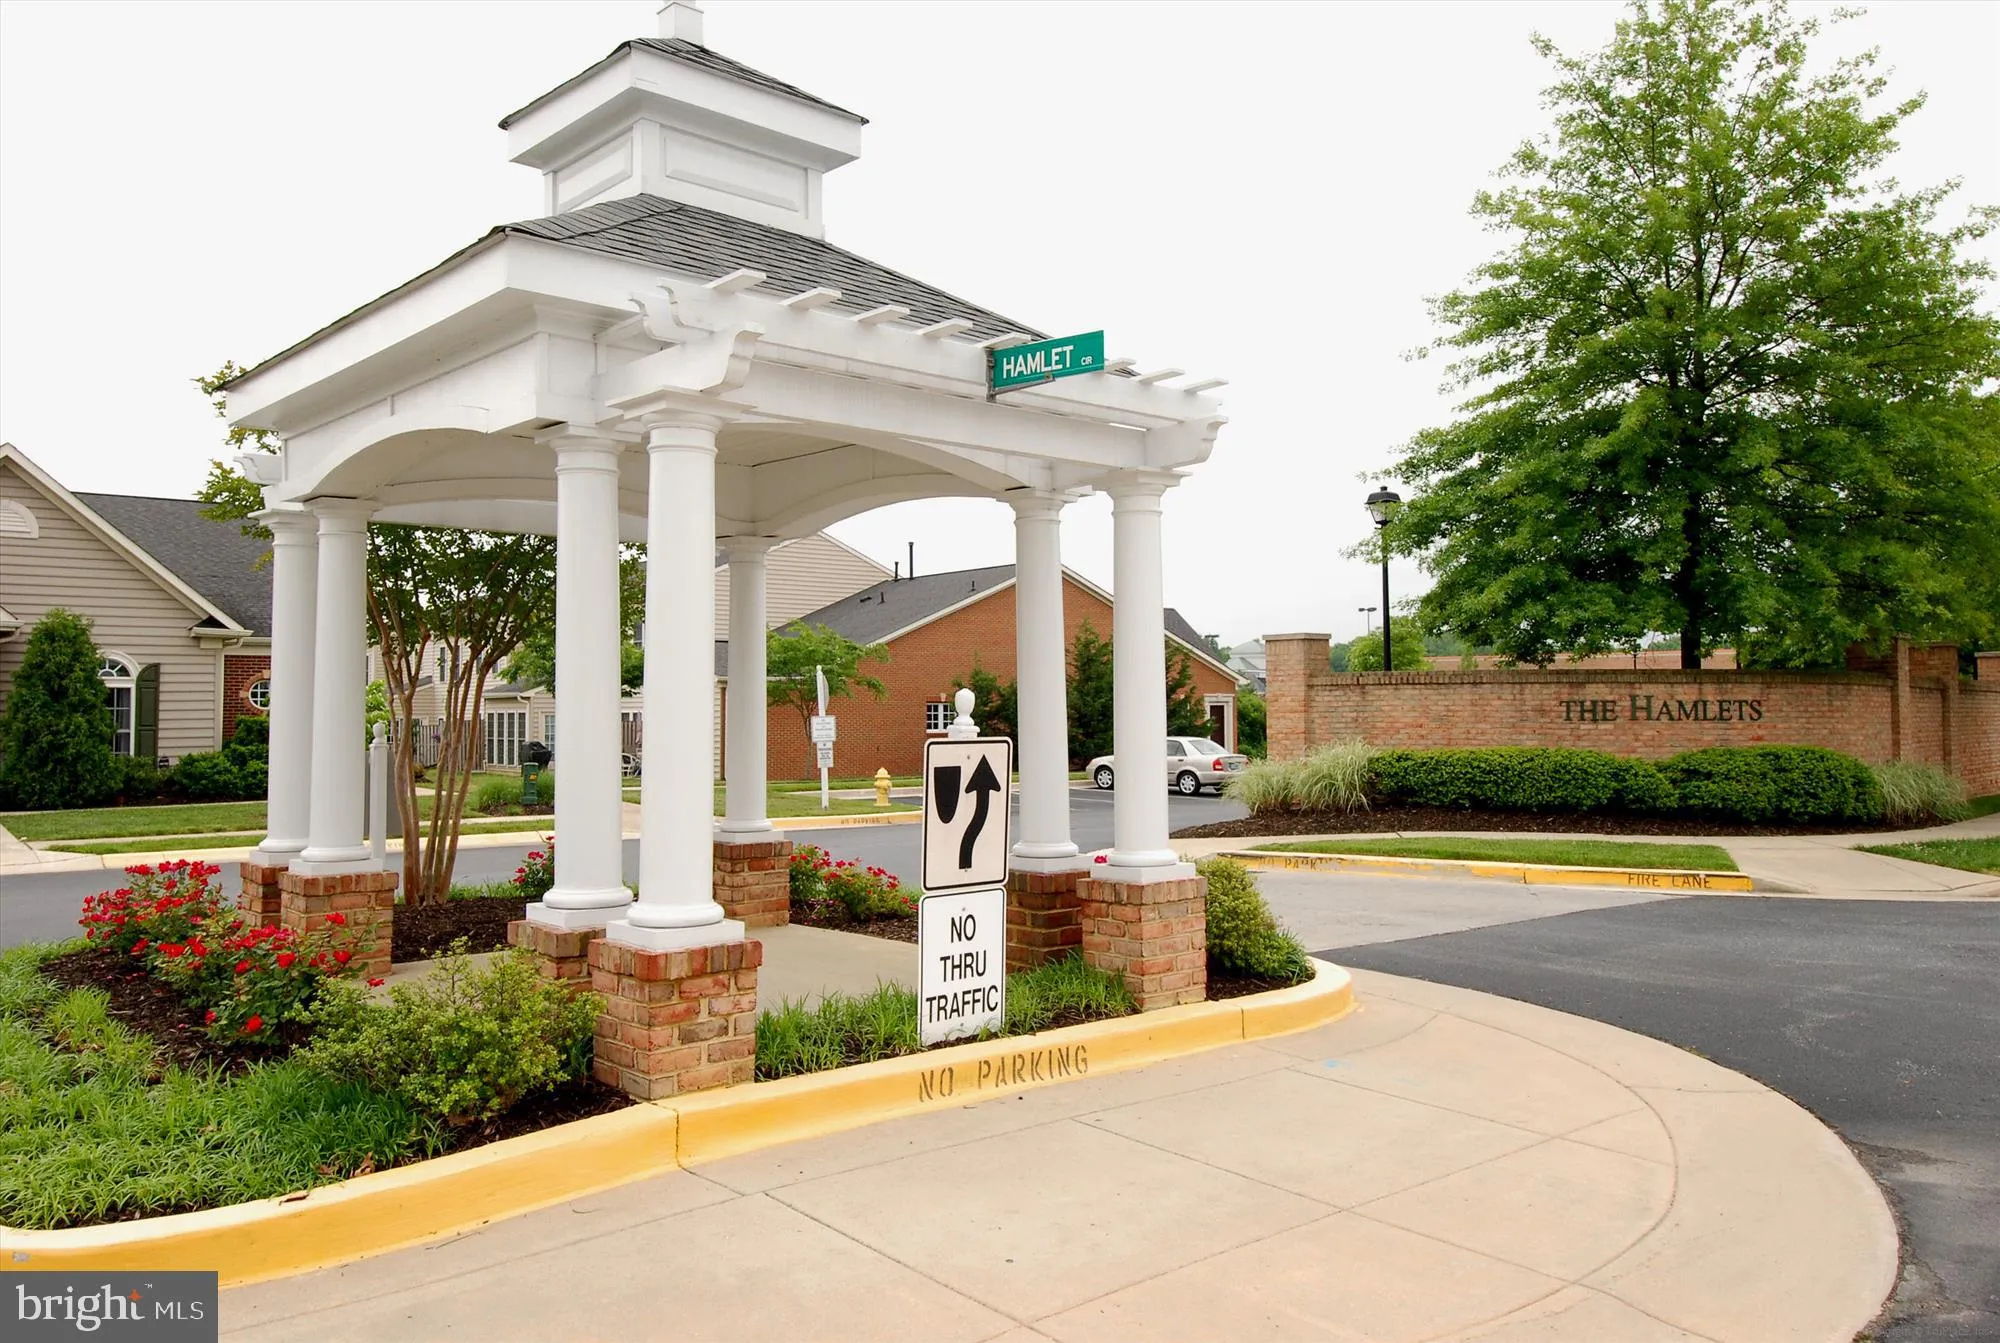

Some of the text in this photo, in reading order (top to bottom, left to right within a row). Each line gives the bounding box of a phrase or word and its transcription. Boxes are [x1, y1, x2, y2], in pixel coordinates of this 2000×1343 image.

[1002, 345, 1093, 379] HAMLET CIR
[1559, 694, 1764, 722] THE HAMLETS
[1627, 872, 1713, 889] FIRE LANE
[950, 913, 977, 944] NO
[939, 950, 987, 983] THRU
[925, 984, 999, 1024] TRAFFIC
[918, 1044, 1089, 1103] NO PARKING
